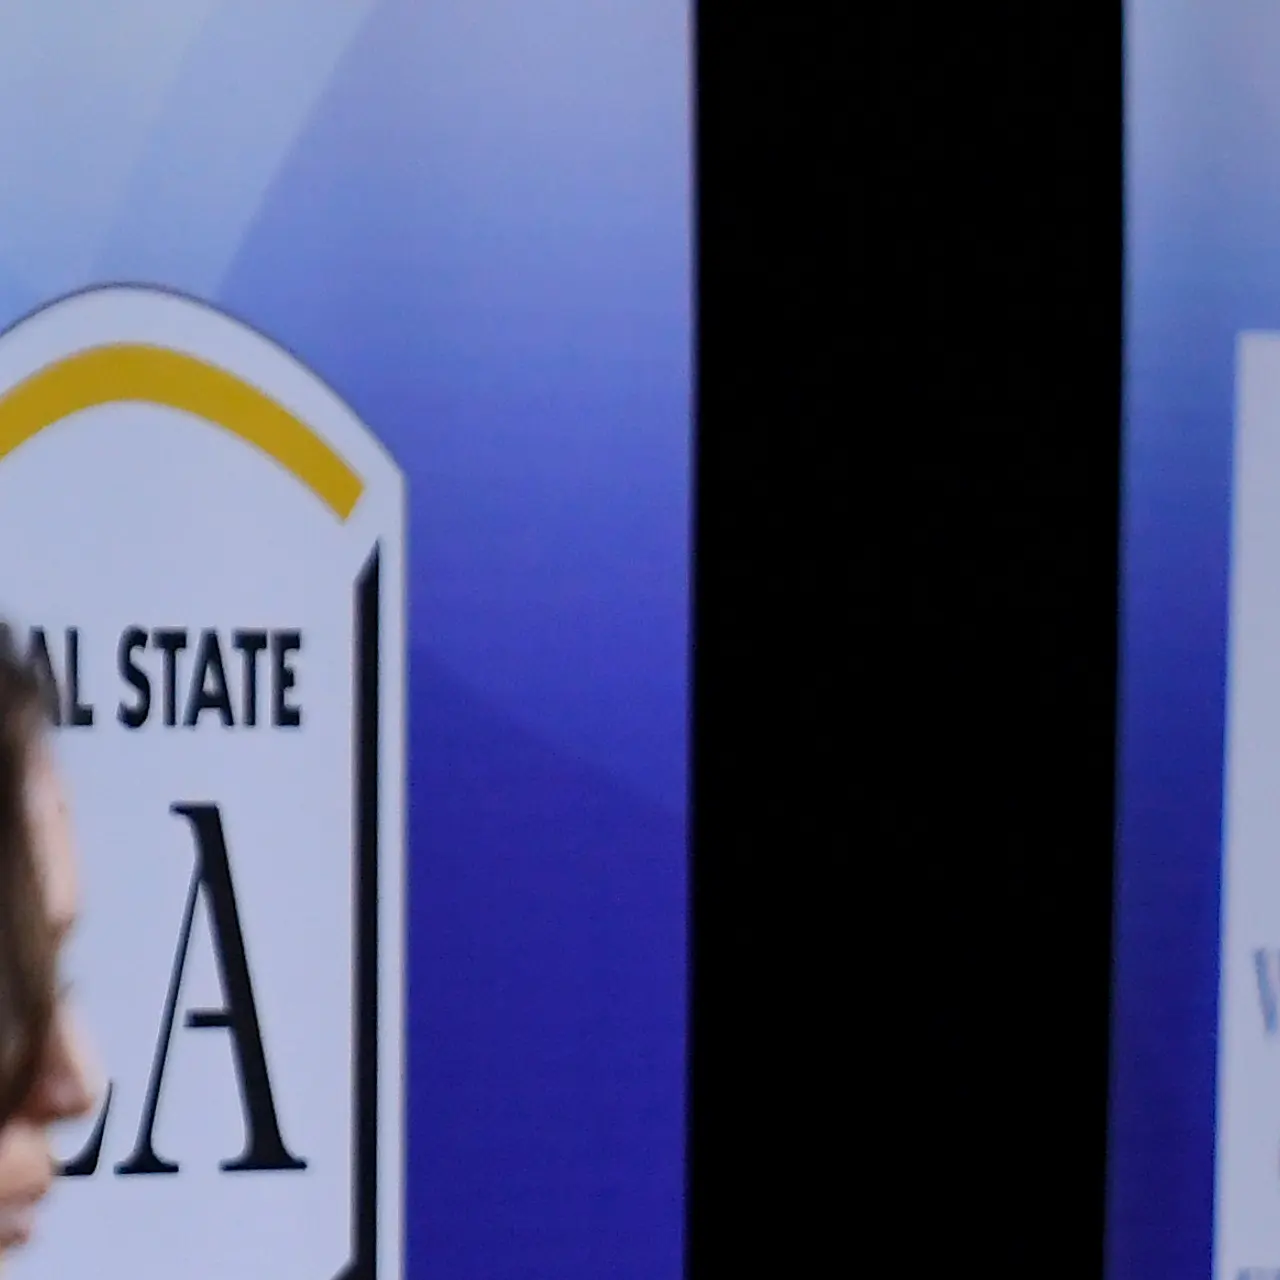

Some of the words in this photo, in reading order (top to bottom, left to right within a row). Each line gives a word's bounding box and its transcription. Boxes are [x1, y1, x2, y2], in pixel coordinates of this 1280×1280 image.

[24, 624, 95, 727] AL
[116, 626, 303, 728] STATE
[52, 802, 309, 1177] A
